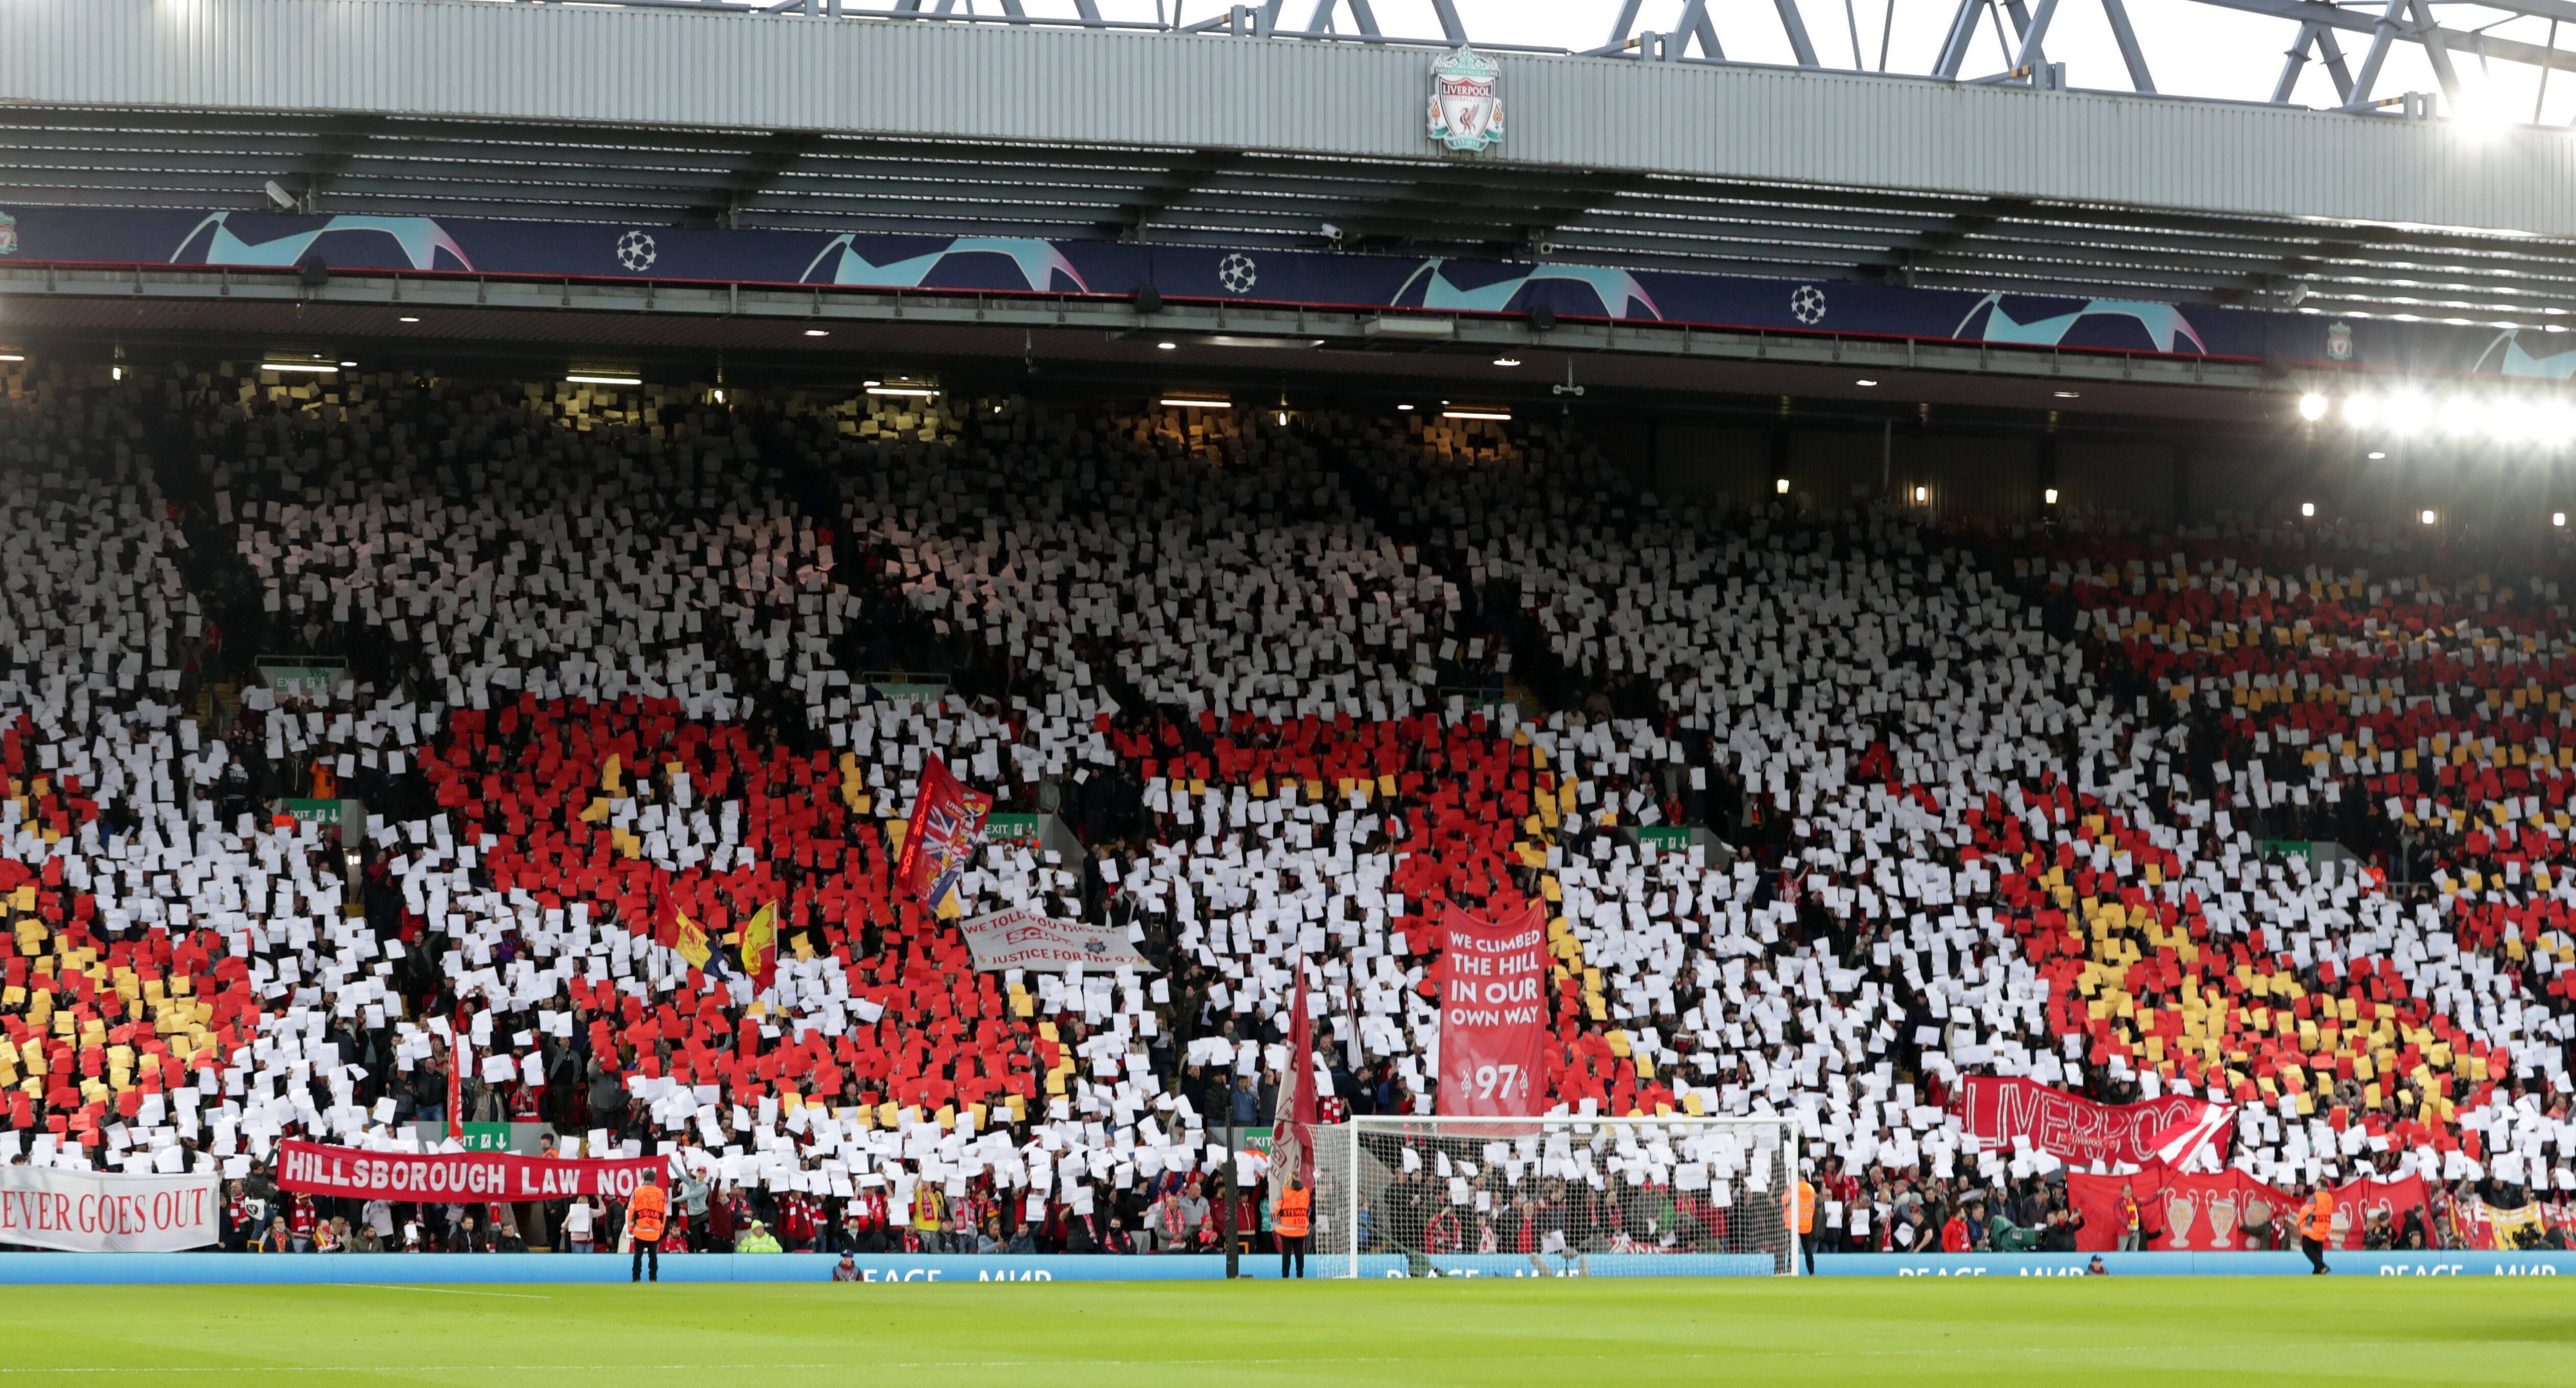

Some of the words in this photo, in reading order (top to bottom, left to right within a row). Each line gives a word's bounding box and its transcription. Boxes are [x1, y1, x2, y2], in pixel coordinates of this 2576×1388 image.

[1443, 84, 1490, 96] LIVERPOOL
[913, 782, 933, 836] SPION
[984, 824, 1009, 834] EXIT
[901, 844, 916, 876] KOP
[965, 923, 987, 933] WE
[989, 910, 1025, 928] TOLD
[1029, 915, 1056, 929] YOU
[1450, 931, 1472, 950] WE
[1476, 930, 1540, 952] CLIMBED
[992, 948, 1050, 964] JUSTICE
[1053, 949, 1082, 961] FOR
[1452, 953, 1492, 975] THE
[1499, 951, 1539, 975] HILL
[1452, 979, 1477, 1004] IN
[1485, 977, 1538, 1004] OUR
[1451, 1008, 1499, 1026] OWN
[1504, 1006, 1539, 1025] WAY
[1475, 1064, 1519, 1100] 97
[285, 1150, 506, 1194] HILLSBOROUGH
[522, 1167, 580, 1195] LAW
[79, 1194, 146, 1235] GOES
[153, 1188, 207, 1230] OUT
